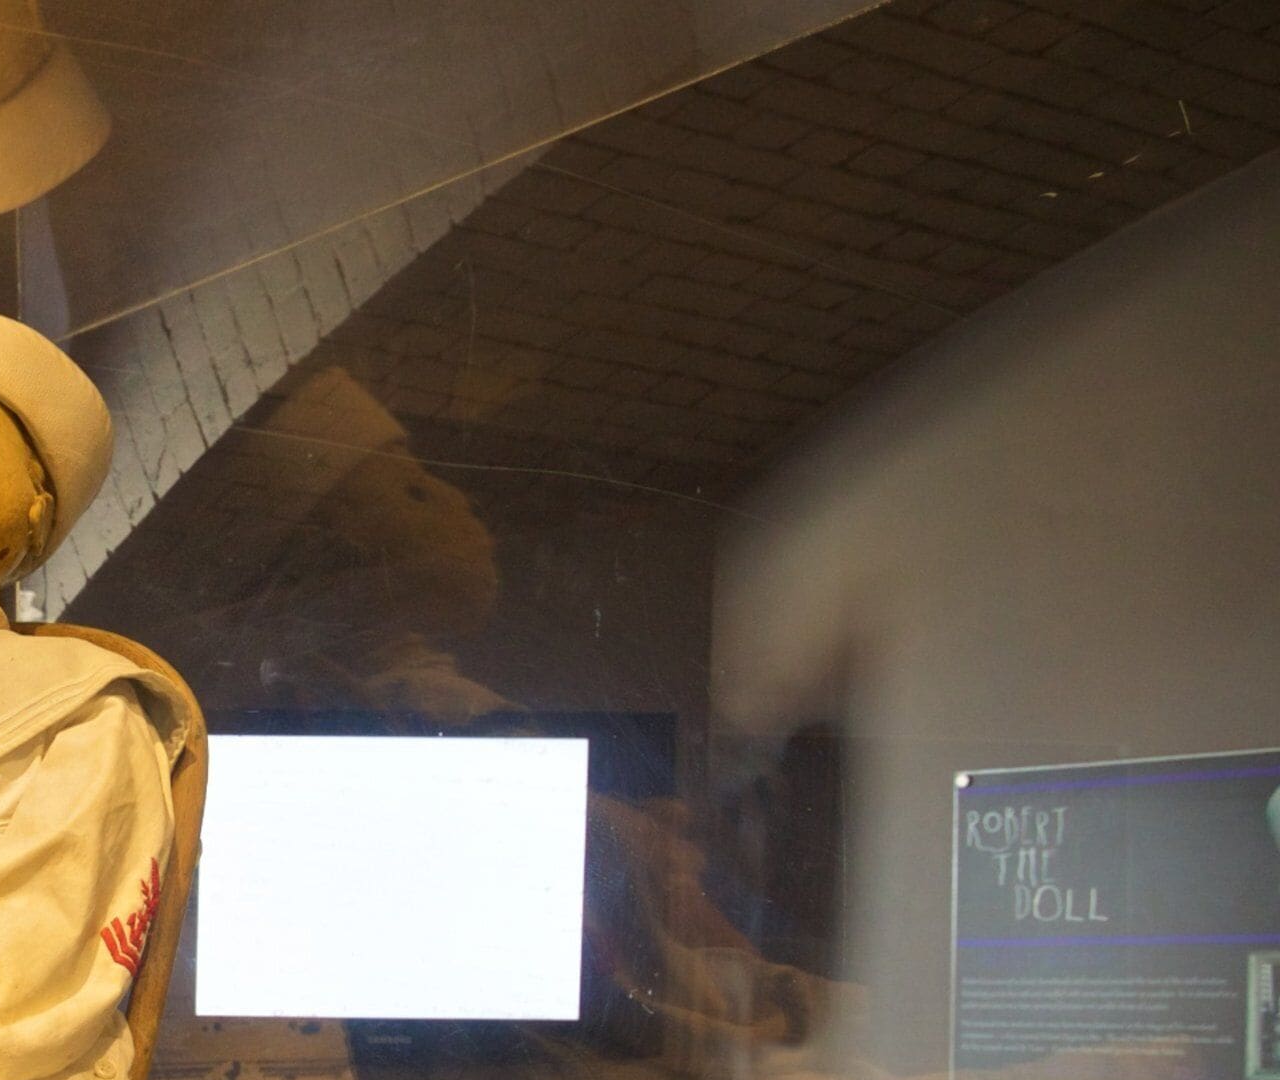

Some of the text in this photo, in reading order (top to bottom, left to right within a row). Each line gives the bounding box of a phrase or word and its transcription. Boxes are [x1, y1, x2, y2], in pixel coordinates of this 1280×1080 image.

[966, 806, 1068, 852] ROBERT
[993, 847, 1055, 887] THE
[1014, 884, 1109, 922] DOLL
